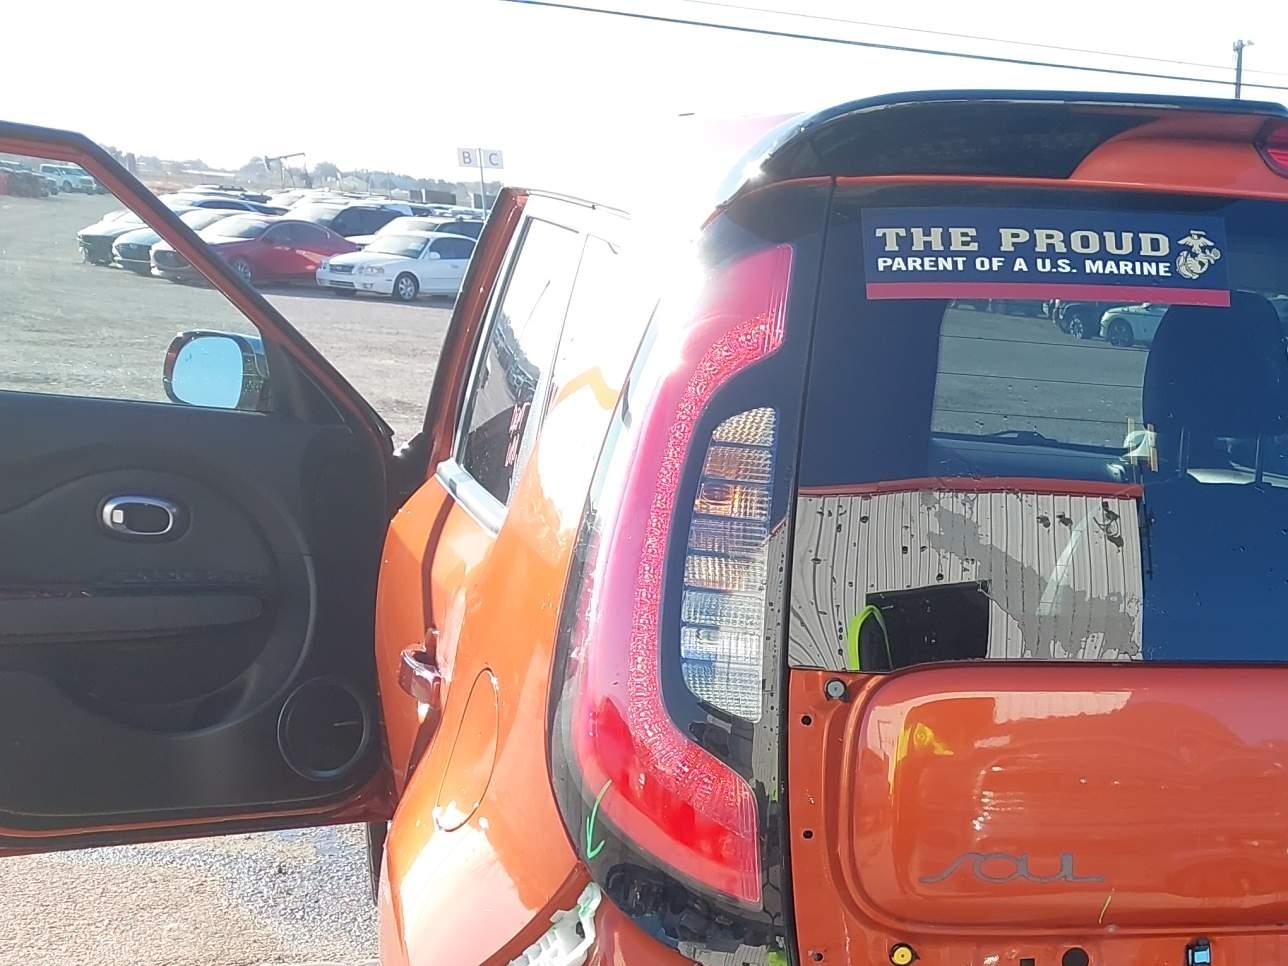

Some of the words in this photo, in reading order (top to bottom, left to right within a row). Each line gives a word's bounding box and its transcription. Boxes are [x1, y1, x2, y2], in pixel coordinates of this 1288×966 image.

[463, 151, 472, 165] B
[489, 152, 499, 166] C
[875, 227, 979, 252] THE
[999, 228, 1170, 257] PROUD
[877, 256, 967, 272] PARENT
[974, 257, 1005, 272] OF
[1013, 258, 1028, 272] A
[1036, 258, 1077, 274] U.S.
[1084, 259, 1172, 277] MARINE
